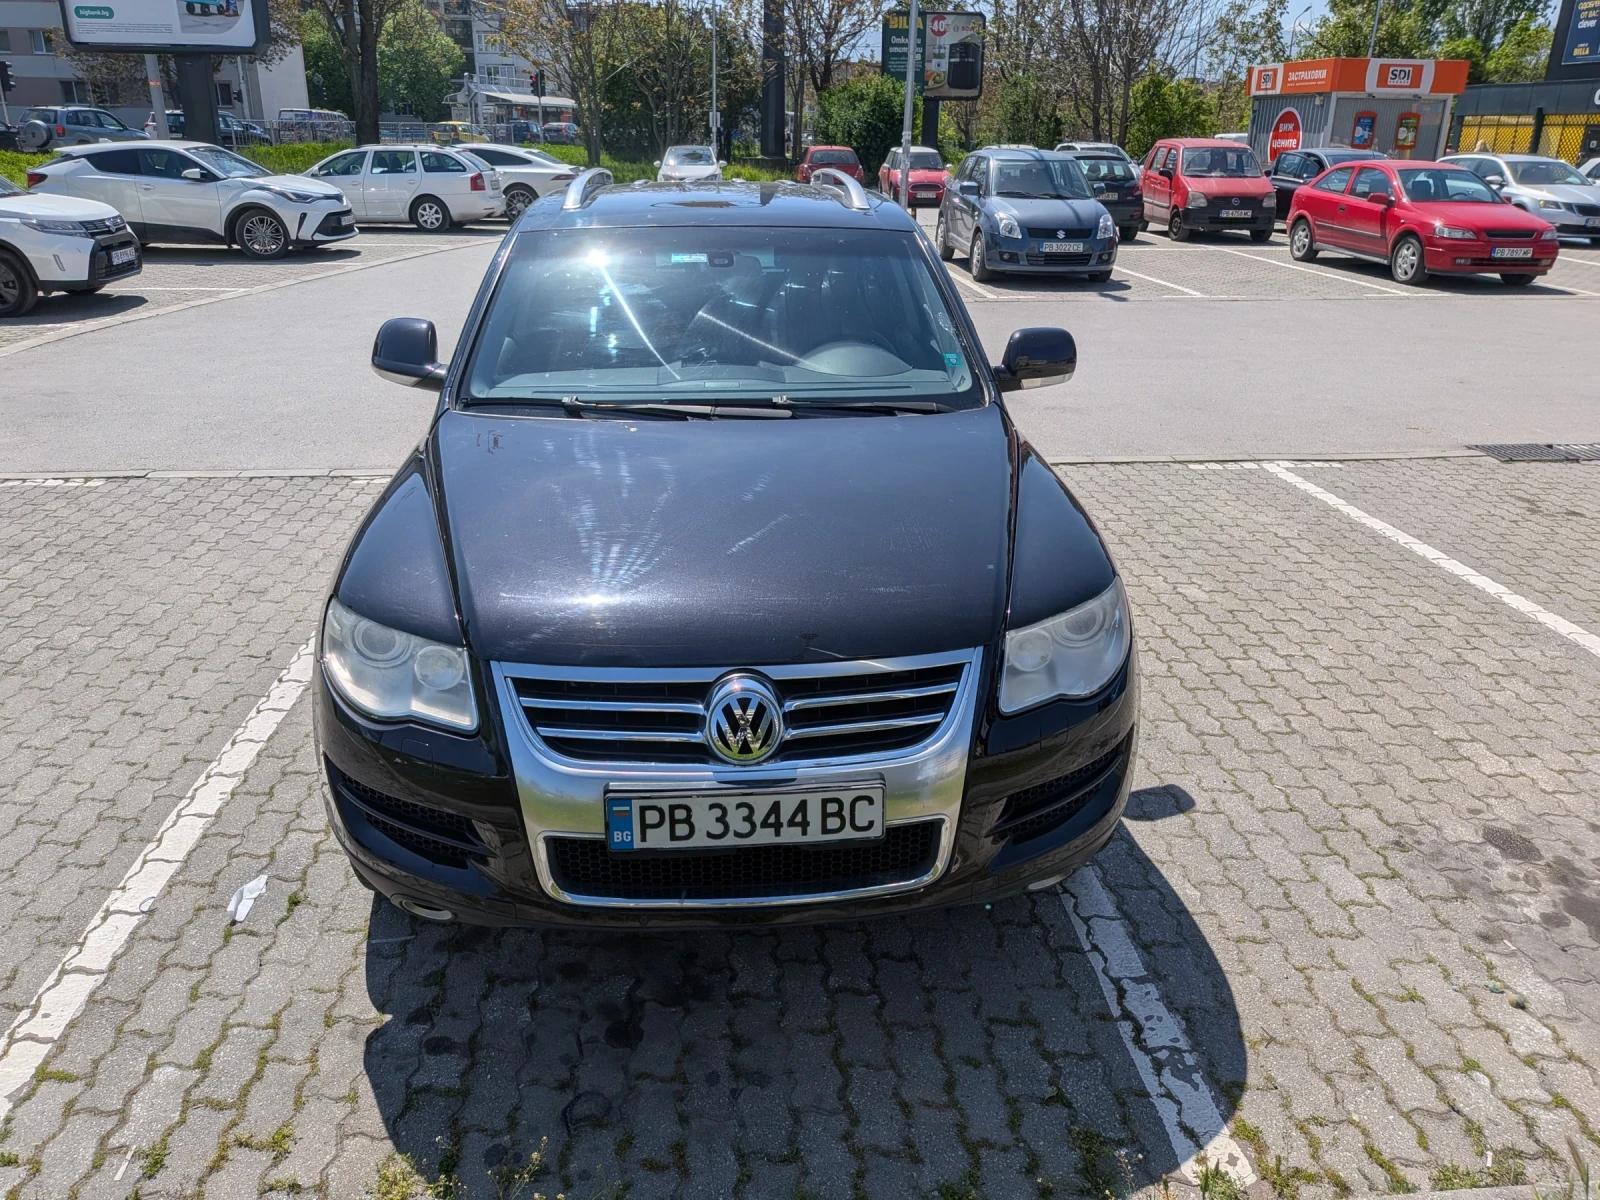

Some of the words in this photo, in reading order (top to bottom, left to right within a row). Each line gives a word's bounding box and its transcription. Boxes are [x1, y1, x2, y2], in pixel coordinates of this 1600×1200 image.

[79, 9, 109, 17] bigbank.bg
[889, 16, 923, 29] BILA
[1578, 19, 1597, 29] clever
[1573, 47, 1590, 56] BILLA
[1262, 73, 1272, 84] SDI
[1288, 69, 1327, 82] ЗАСТРАХОВКИ
[1390, 69, 1411, 80] SDI
[1272, 139, 1297, 149] цените
[1045, 244, 1053, 252] PB
[1055, 244, 1072, 252] 3022
[613, 831, 632, 843] BG
[639, 803, 696, 843] PB
[705, 799, 811, 840] 3344
[821, 795, 875, 836] BC
